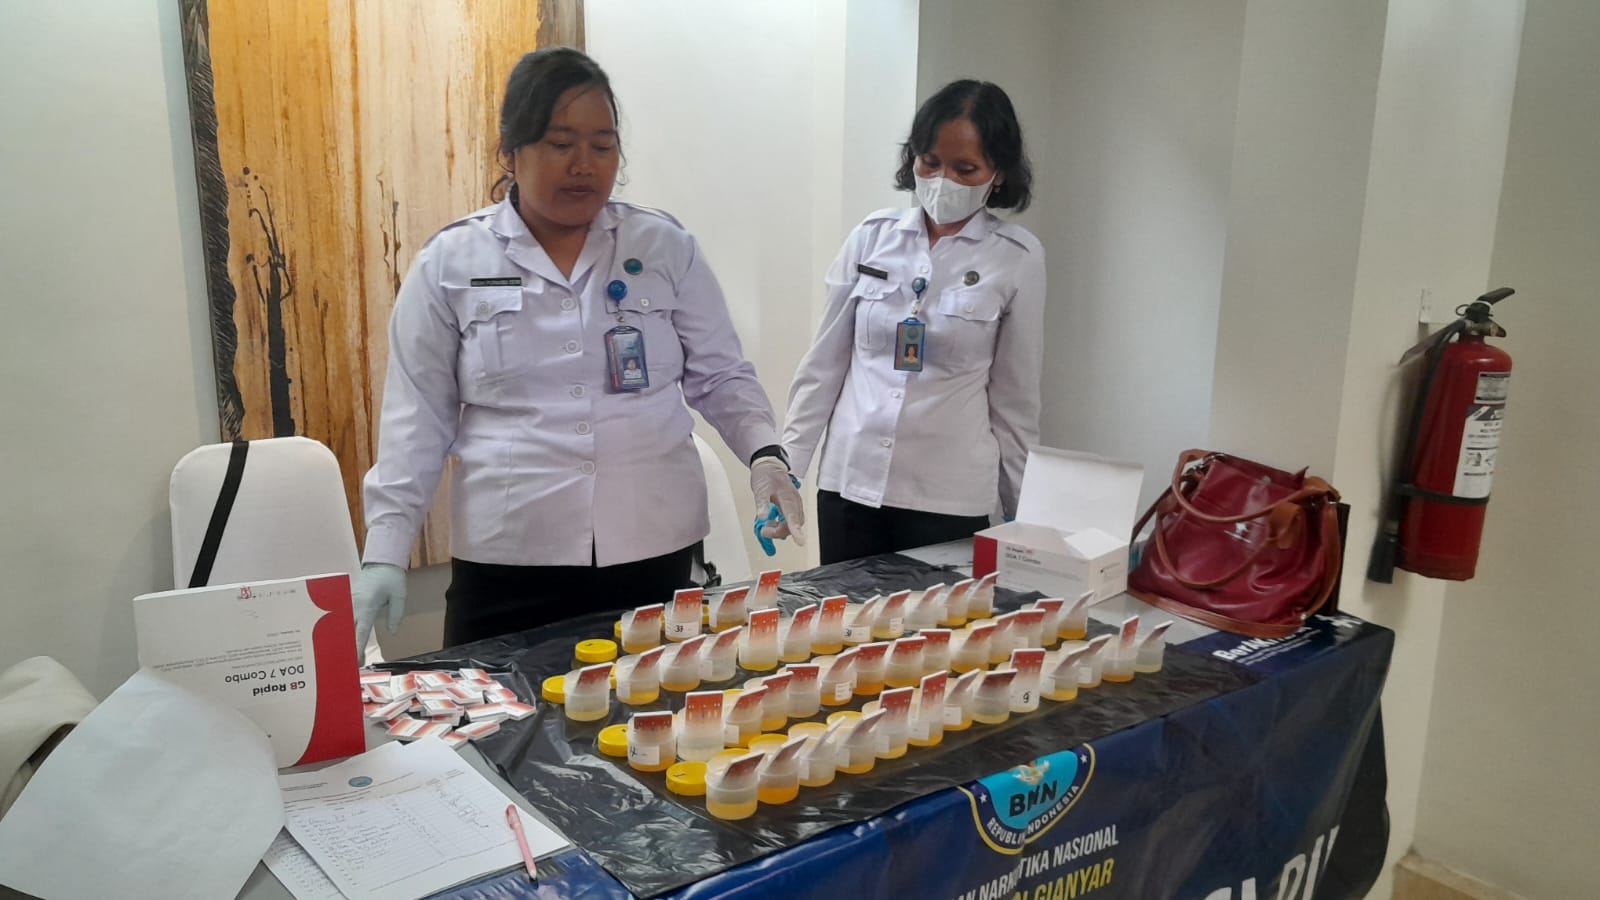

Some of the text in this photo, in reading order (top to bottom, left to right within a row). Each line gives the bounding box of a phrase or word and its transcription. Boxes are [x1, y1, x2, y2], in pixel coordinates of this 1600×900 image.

[224, 664, 304, 684] DOA 7 Combo
[252, 680, 306, 697] GB Rapid
[1027, 785, 1080, 835] NDONESIA
[1052, 824, 1119, 868] NASIONAL
[1034, 858, 1115, 900] GIANYAR
